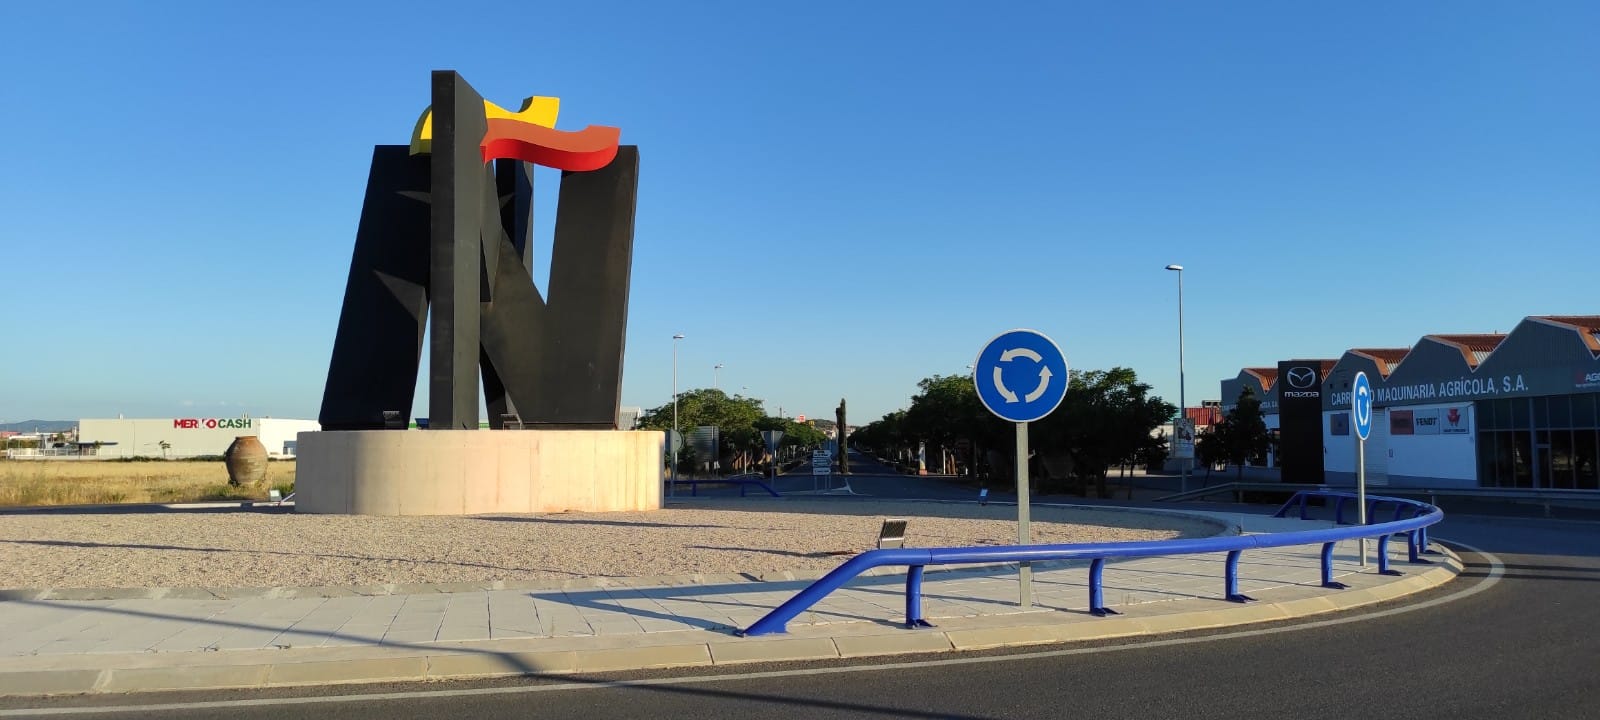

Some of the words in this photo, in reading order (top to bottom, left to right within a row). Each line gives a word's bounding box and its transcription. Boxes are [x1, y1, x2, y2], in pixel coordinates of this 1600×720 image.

[1377, 382, 1435, 402] MAQUINARIA
[1439, 375, 1499, 396] AGRÍCOLA,
[1503, 373, 1529, 392] S.A.
[218, 418, 252, 429] CASH
[1416, 417, 1437, 425] FENDT
